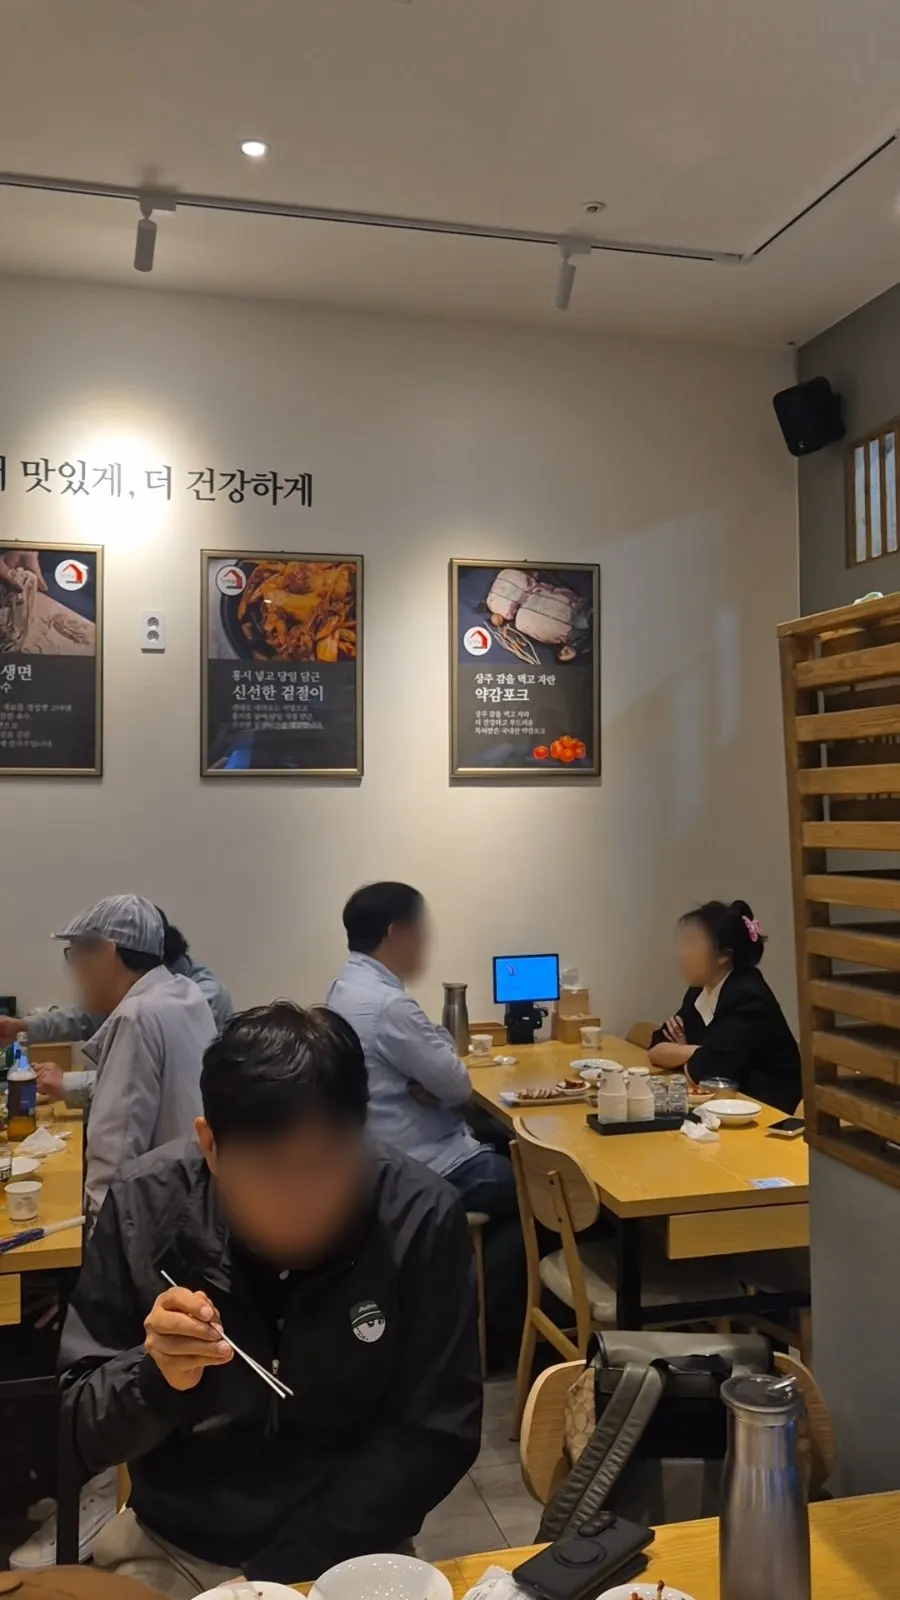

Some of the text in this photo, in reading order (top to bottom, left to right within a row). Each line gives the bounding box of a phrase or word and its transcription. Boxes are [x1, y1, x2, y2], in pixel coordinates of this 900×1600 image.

[20, 457, 135, 499] 맛있게,
[145, 465, 172, 500] 더
[186, 467, 313, 507] 건강하게
[0, 664, 33, 681] 생면
[232, 670, 320, 683] 홍시 넣고 당일 담근
[474, 673, 556, 686] 상주 감을 먹고 자란
[232, 684, 323, 702] 신선한 겉절이
[475, 687, 530, 703] 약감포크
